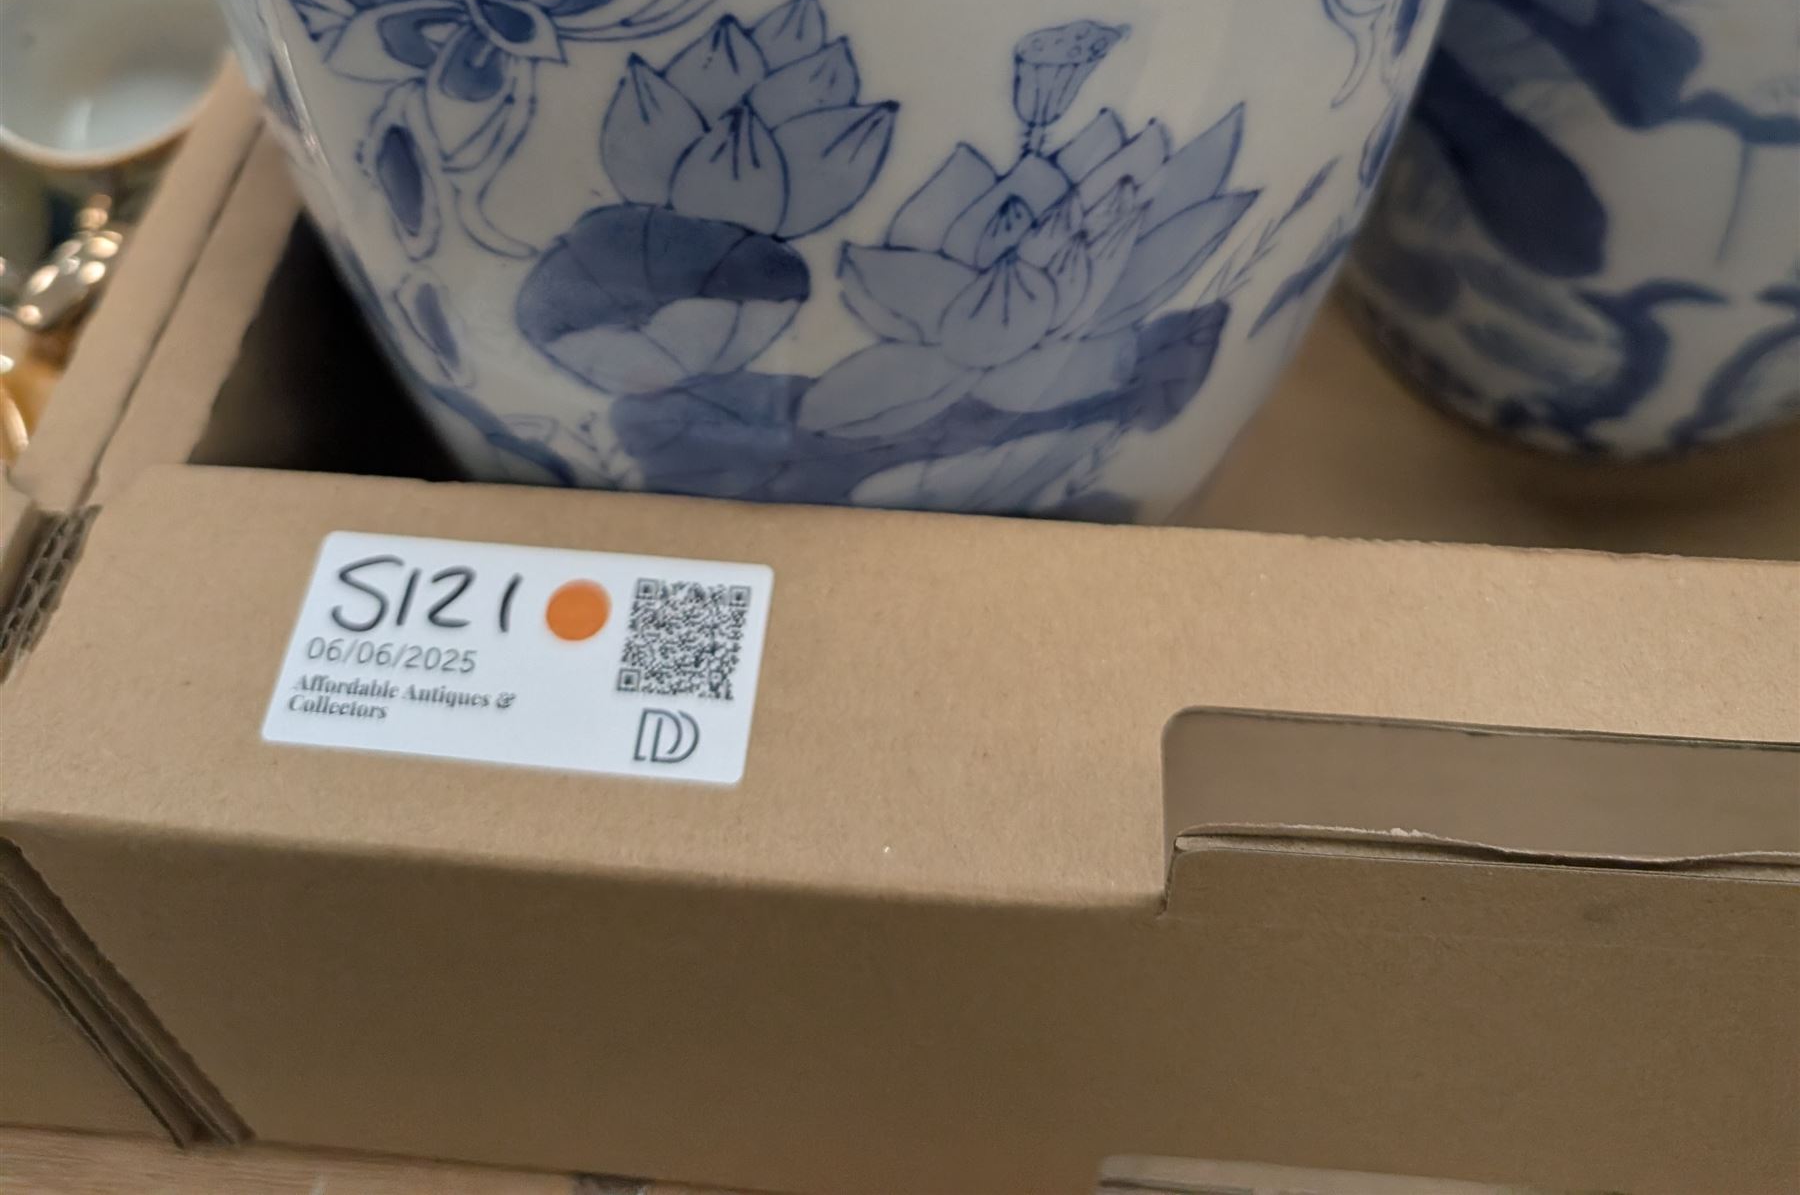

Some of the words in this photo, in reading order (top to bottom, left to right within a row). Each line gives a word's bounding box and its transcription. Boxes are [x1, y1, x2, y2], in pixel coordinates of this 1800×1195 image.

[331, 554, 523, 633] S121
[306, 636, 478, 674] 06/06/2025
[287, 693, 388, 720] Collectors
[294, 674, 400, 700] Affordable
[401, 683, 491, 708] Antiques
[494, 691, 517, 710] &
